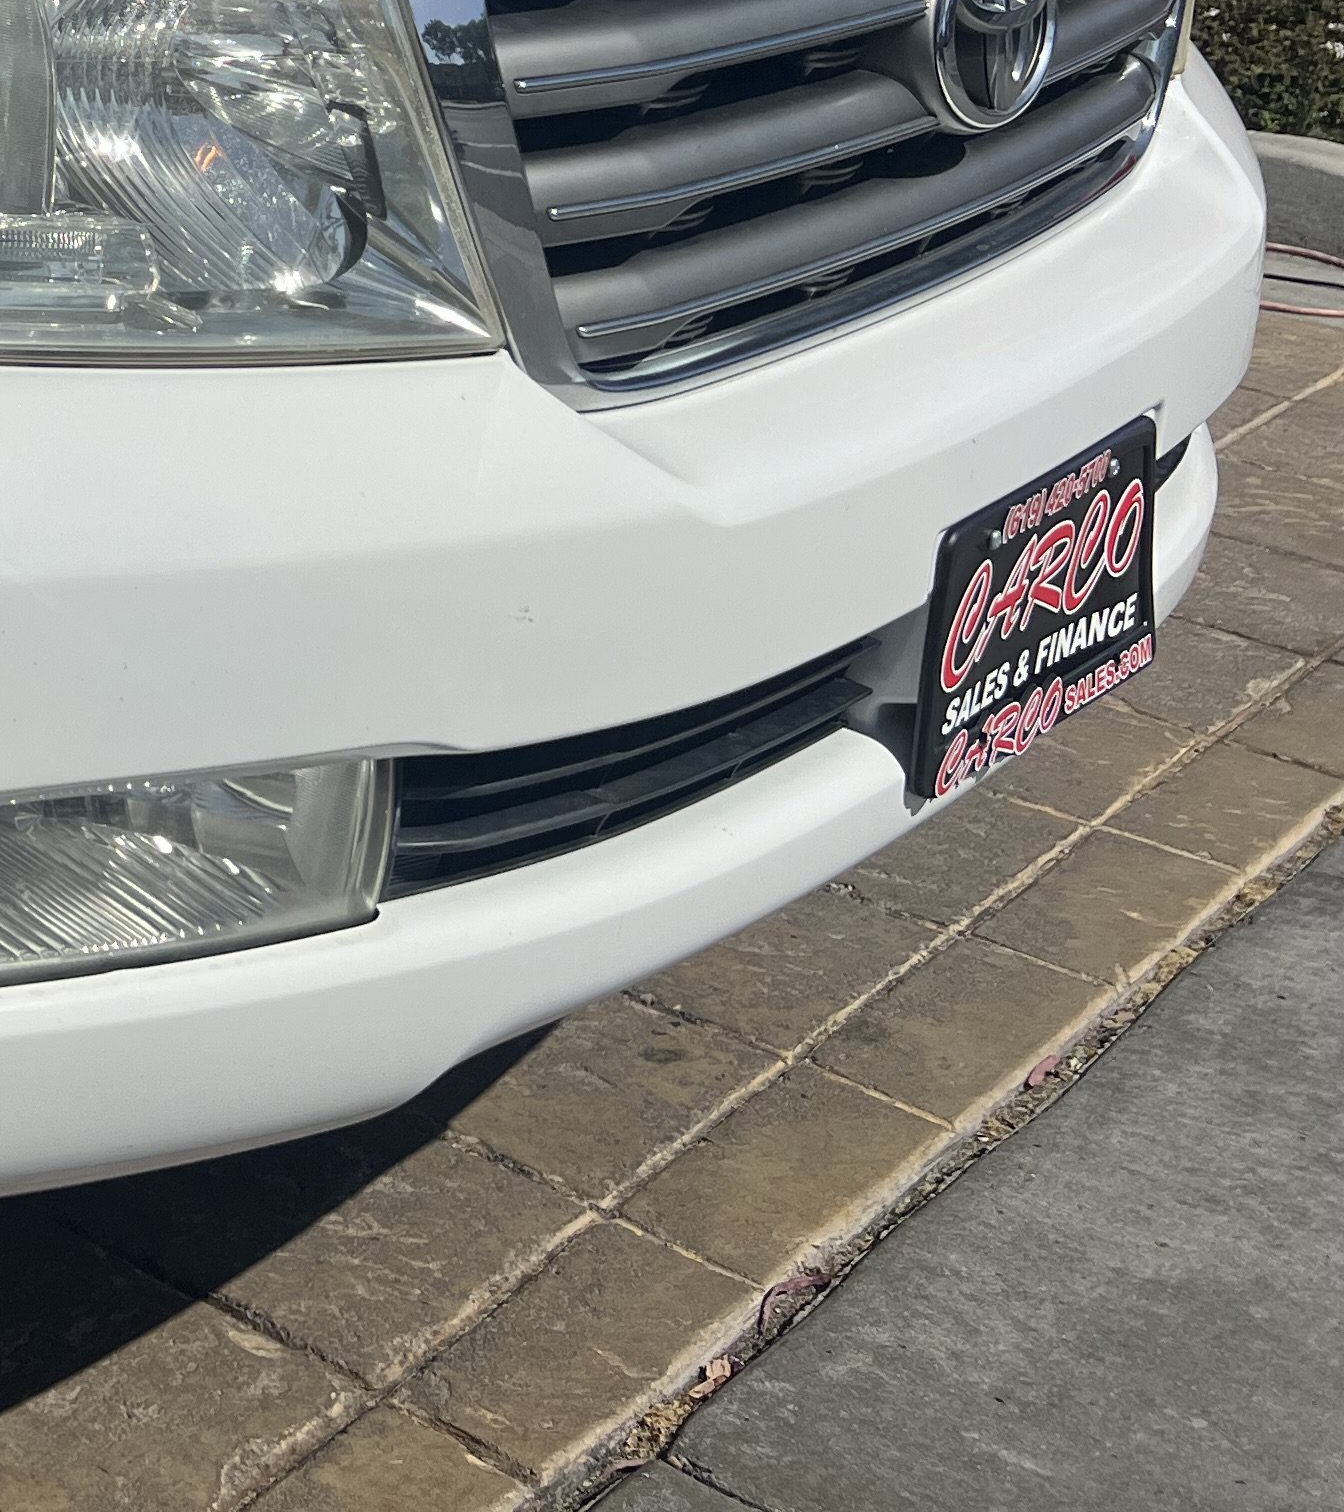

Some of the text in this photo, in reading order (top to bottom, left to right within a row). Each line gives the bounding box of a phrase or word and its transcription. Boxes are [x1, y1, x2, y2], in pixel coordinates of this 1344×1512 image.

[940, 478, 1144, 694] CARCO
[1002, 488, 1047, 545] (619)
[935, 633, 1153, 798] CARCO SALES.COM
[941, 592, 1139, 736] SALES & FINANCE
